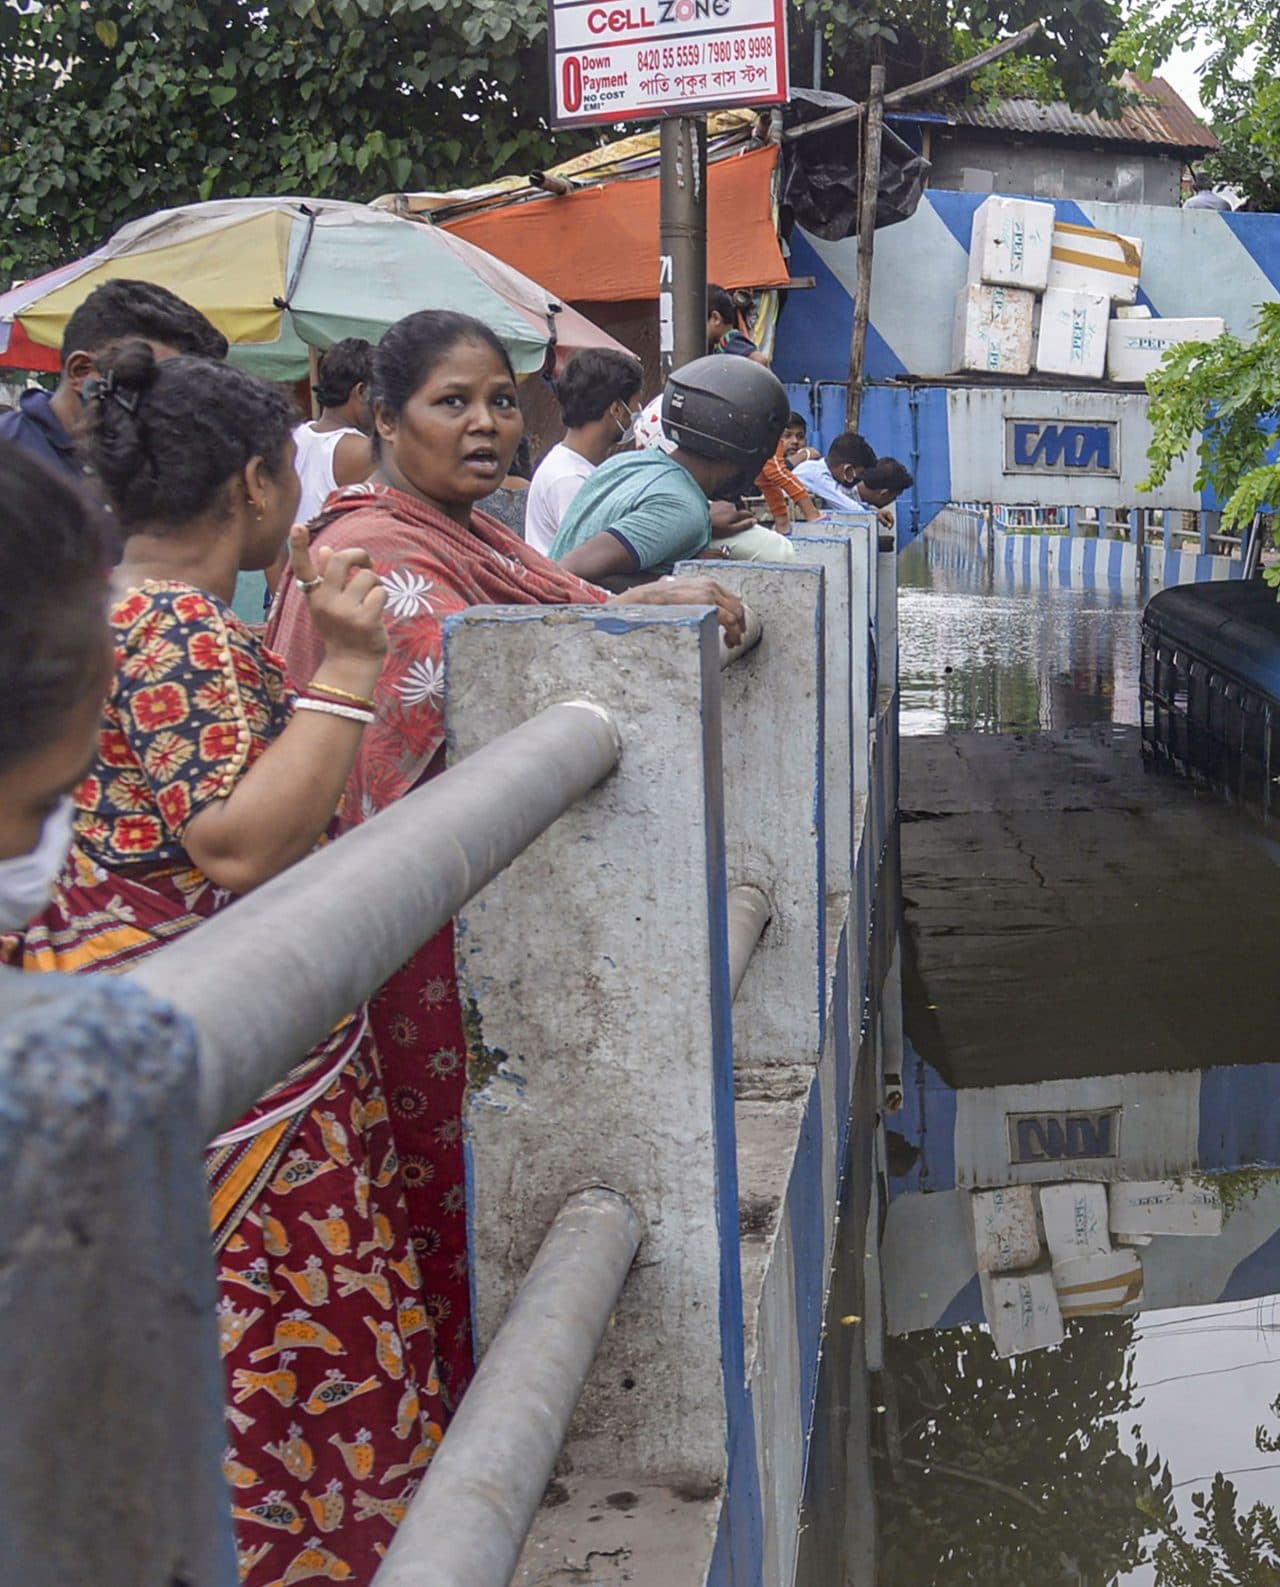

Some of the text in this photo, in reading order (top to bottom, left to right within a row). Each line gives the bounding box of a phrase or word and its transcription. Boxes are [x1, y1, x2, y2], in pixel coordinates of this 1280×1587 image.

[582, 55, 611, 70] Down
[637, 49, 660, 72] 8420
[663, 47, 675, 68] 55
[677, 44, 700, 66] 5559
[708, 40, 731, 63] 7980
[734, 38, 746, 60] 98
[748, 35, 773, 58] 9998
[583, 71, 628, 93] Payment
[639, 73, 671, 95] পাতি
[674, 74, 707, 96] পুকুর
[711, 70, 736, 87] বাস
[583, 91, 625, 103] NO COST
